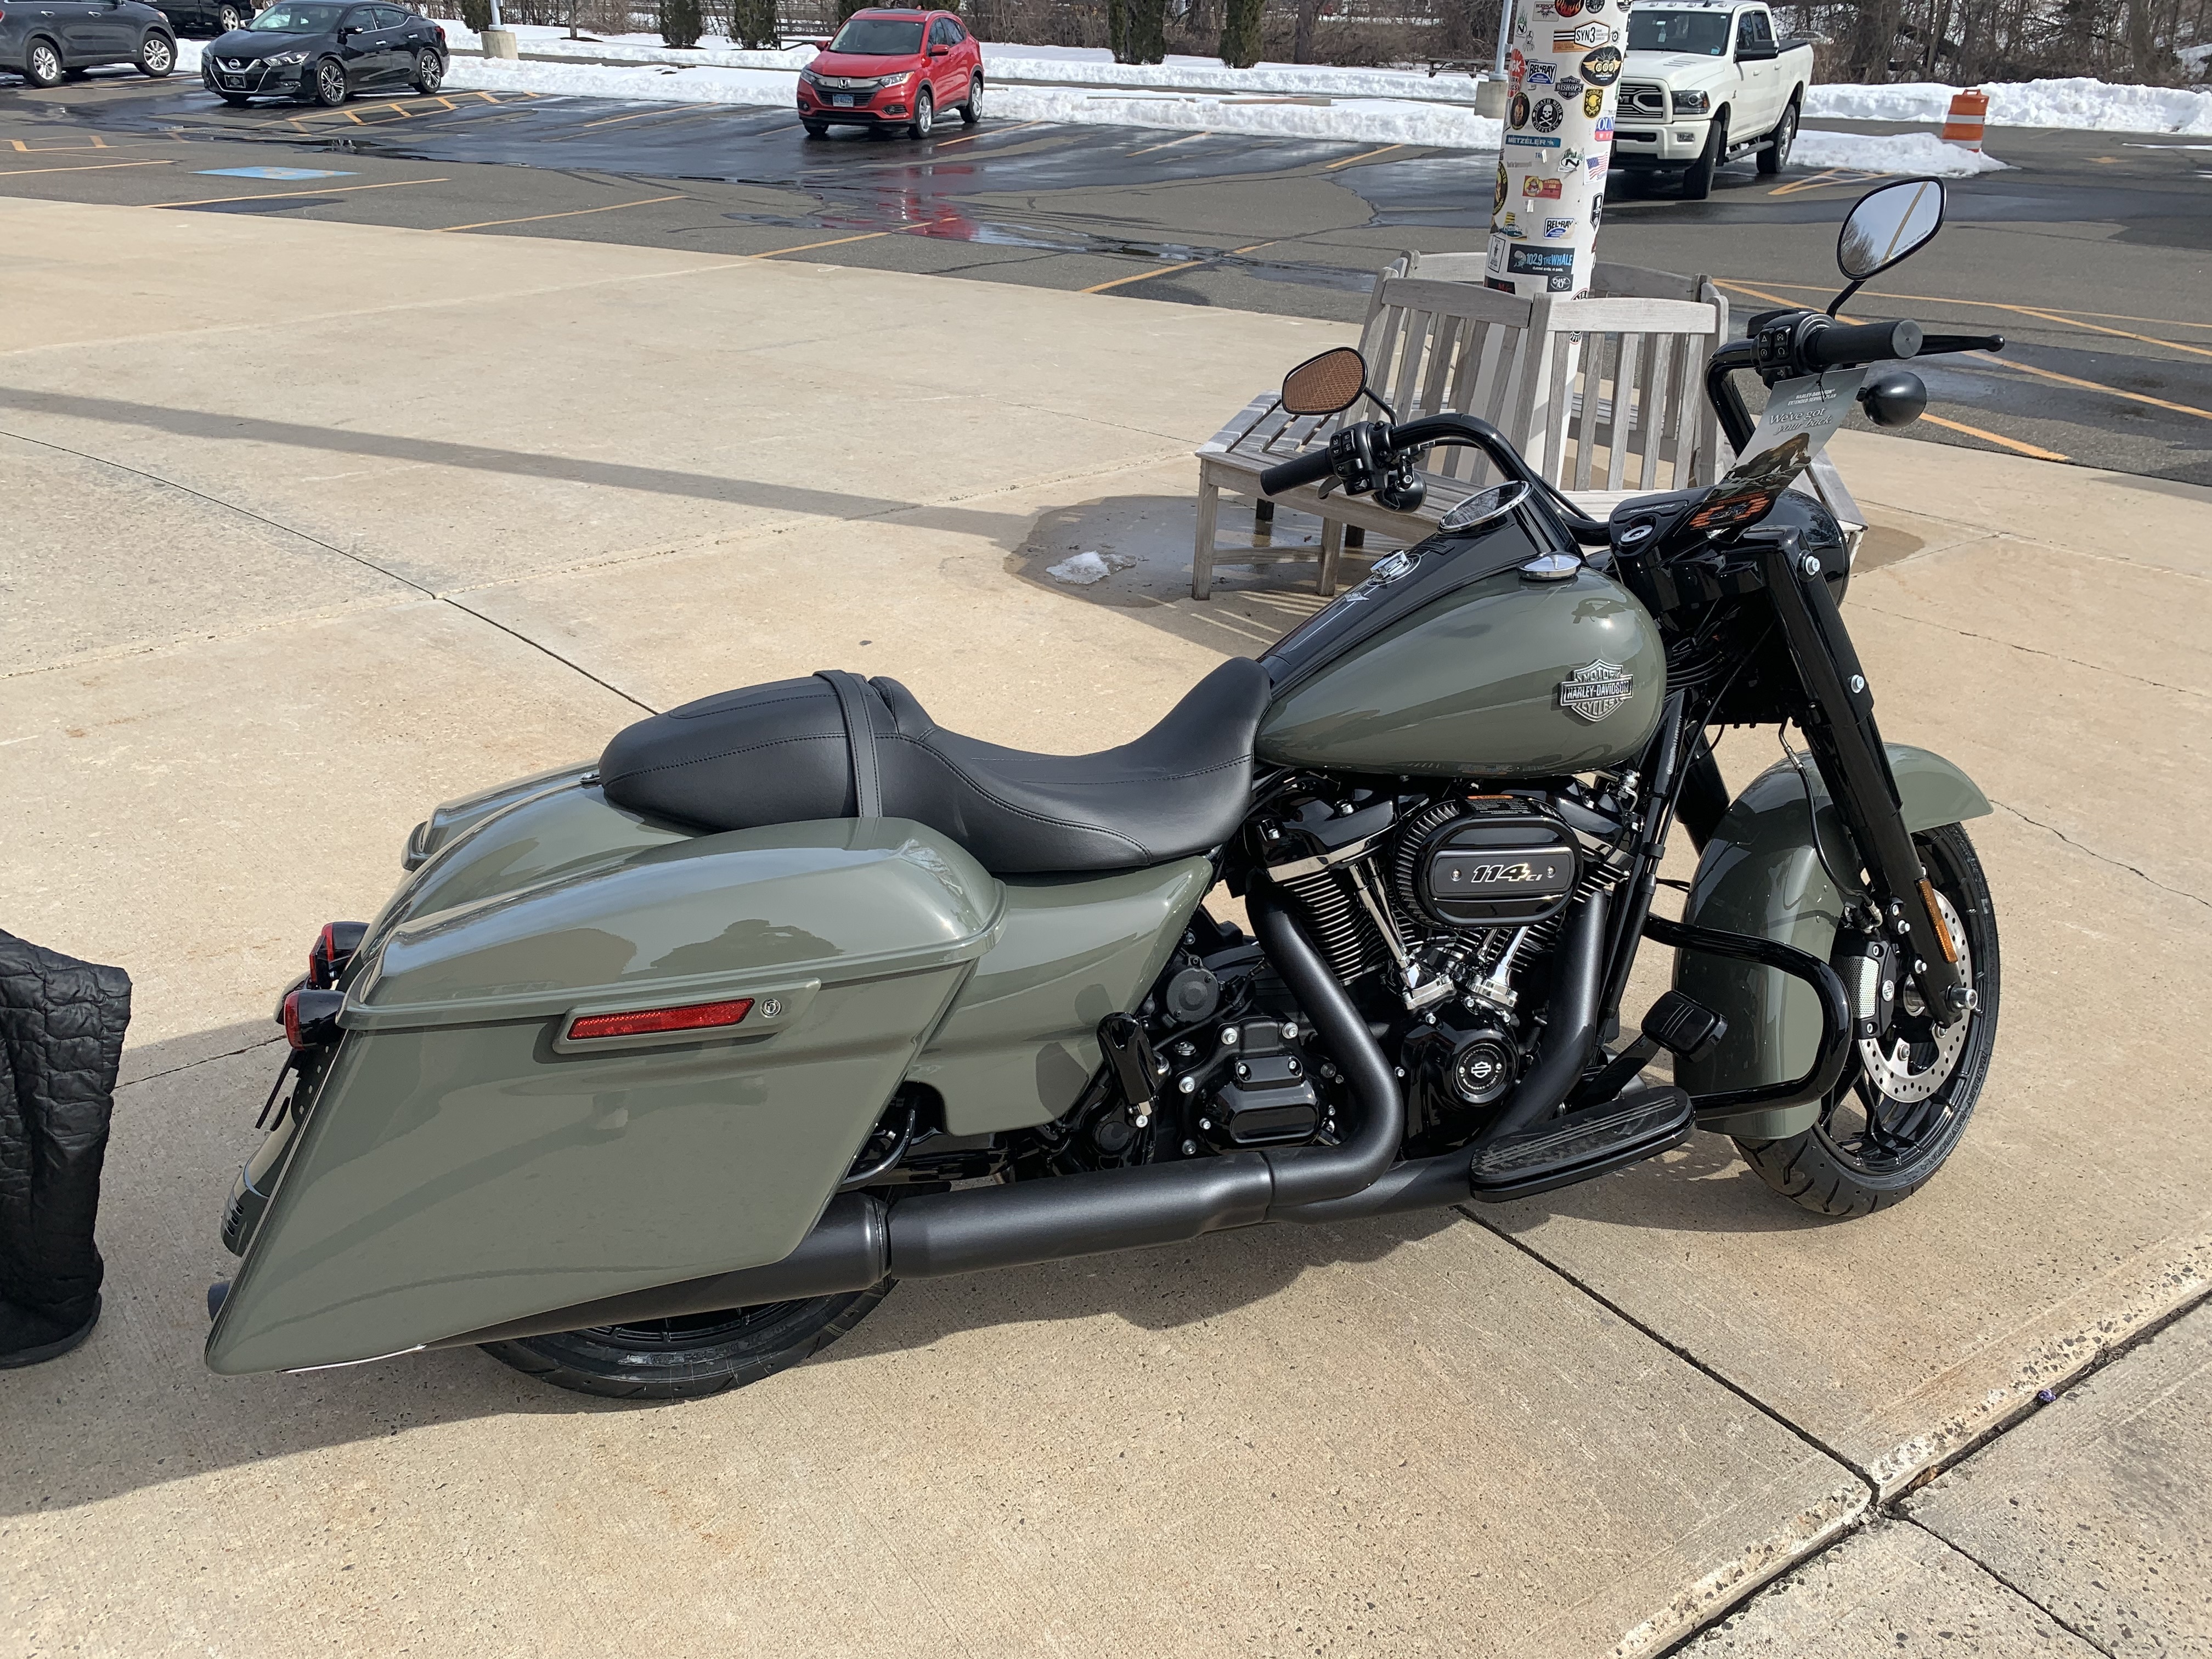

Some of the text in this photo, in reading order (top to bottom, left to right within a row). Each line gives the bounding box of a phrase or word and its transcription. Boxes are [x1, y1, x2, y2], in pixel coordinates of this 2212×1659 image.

[1534, 99, 1562, 113] DEATH WISH
[1533, 121, 1553, 132] COFFEE
[1508, 137, 1546, 145] METZELER
[1526, 253, 1573, 266] 102.9 THE WHALE
[1770, 408, 1826, 425] We've got
[1773, 415, 1832, 436] your back.
[1583, 667, 1616, 681] MOTOR
[1567, 680, 1629, 699] HARLEY-DAVIDSON
[1582, 699, 1615, 715] CYCLES
[1471, 863, 1530, 883] 114
[1464, 1048, 1499, 1064] HARLEY-DAVIDSON
[1928, 1051, 1988, 1165] HARLEY-DAVIDSON
